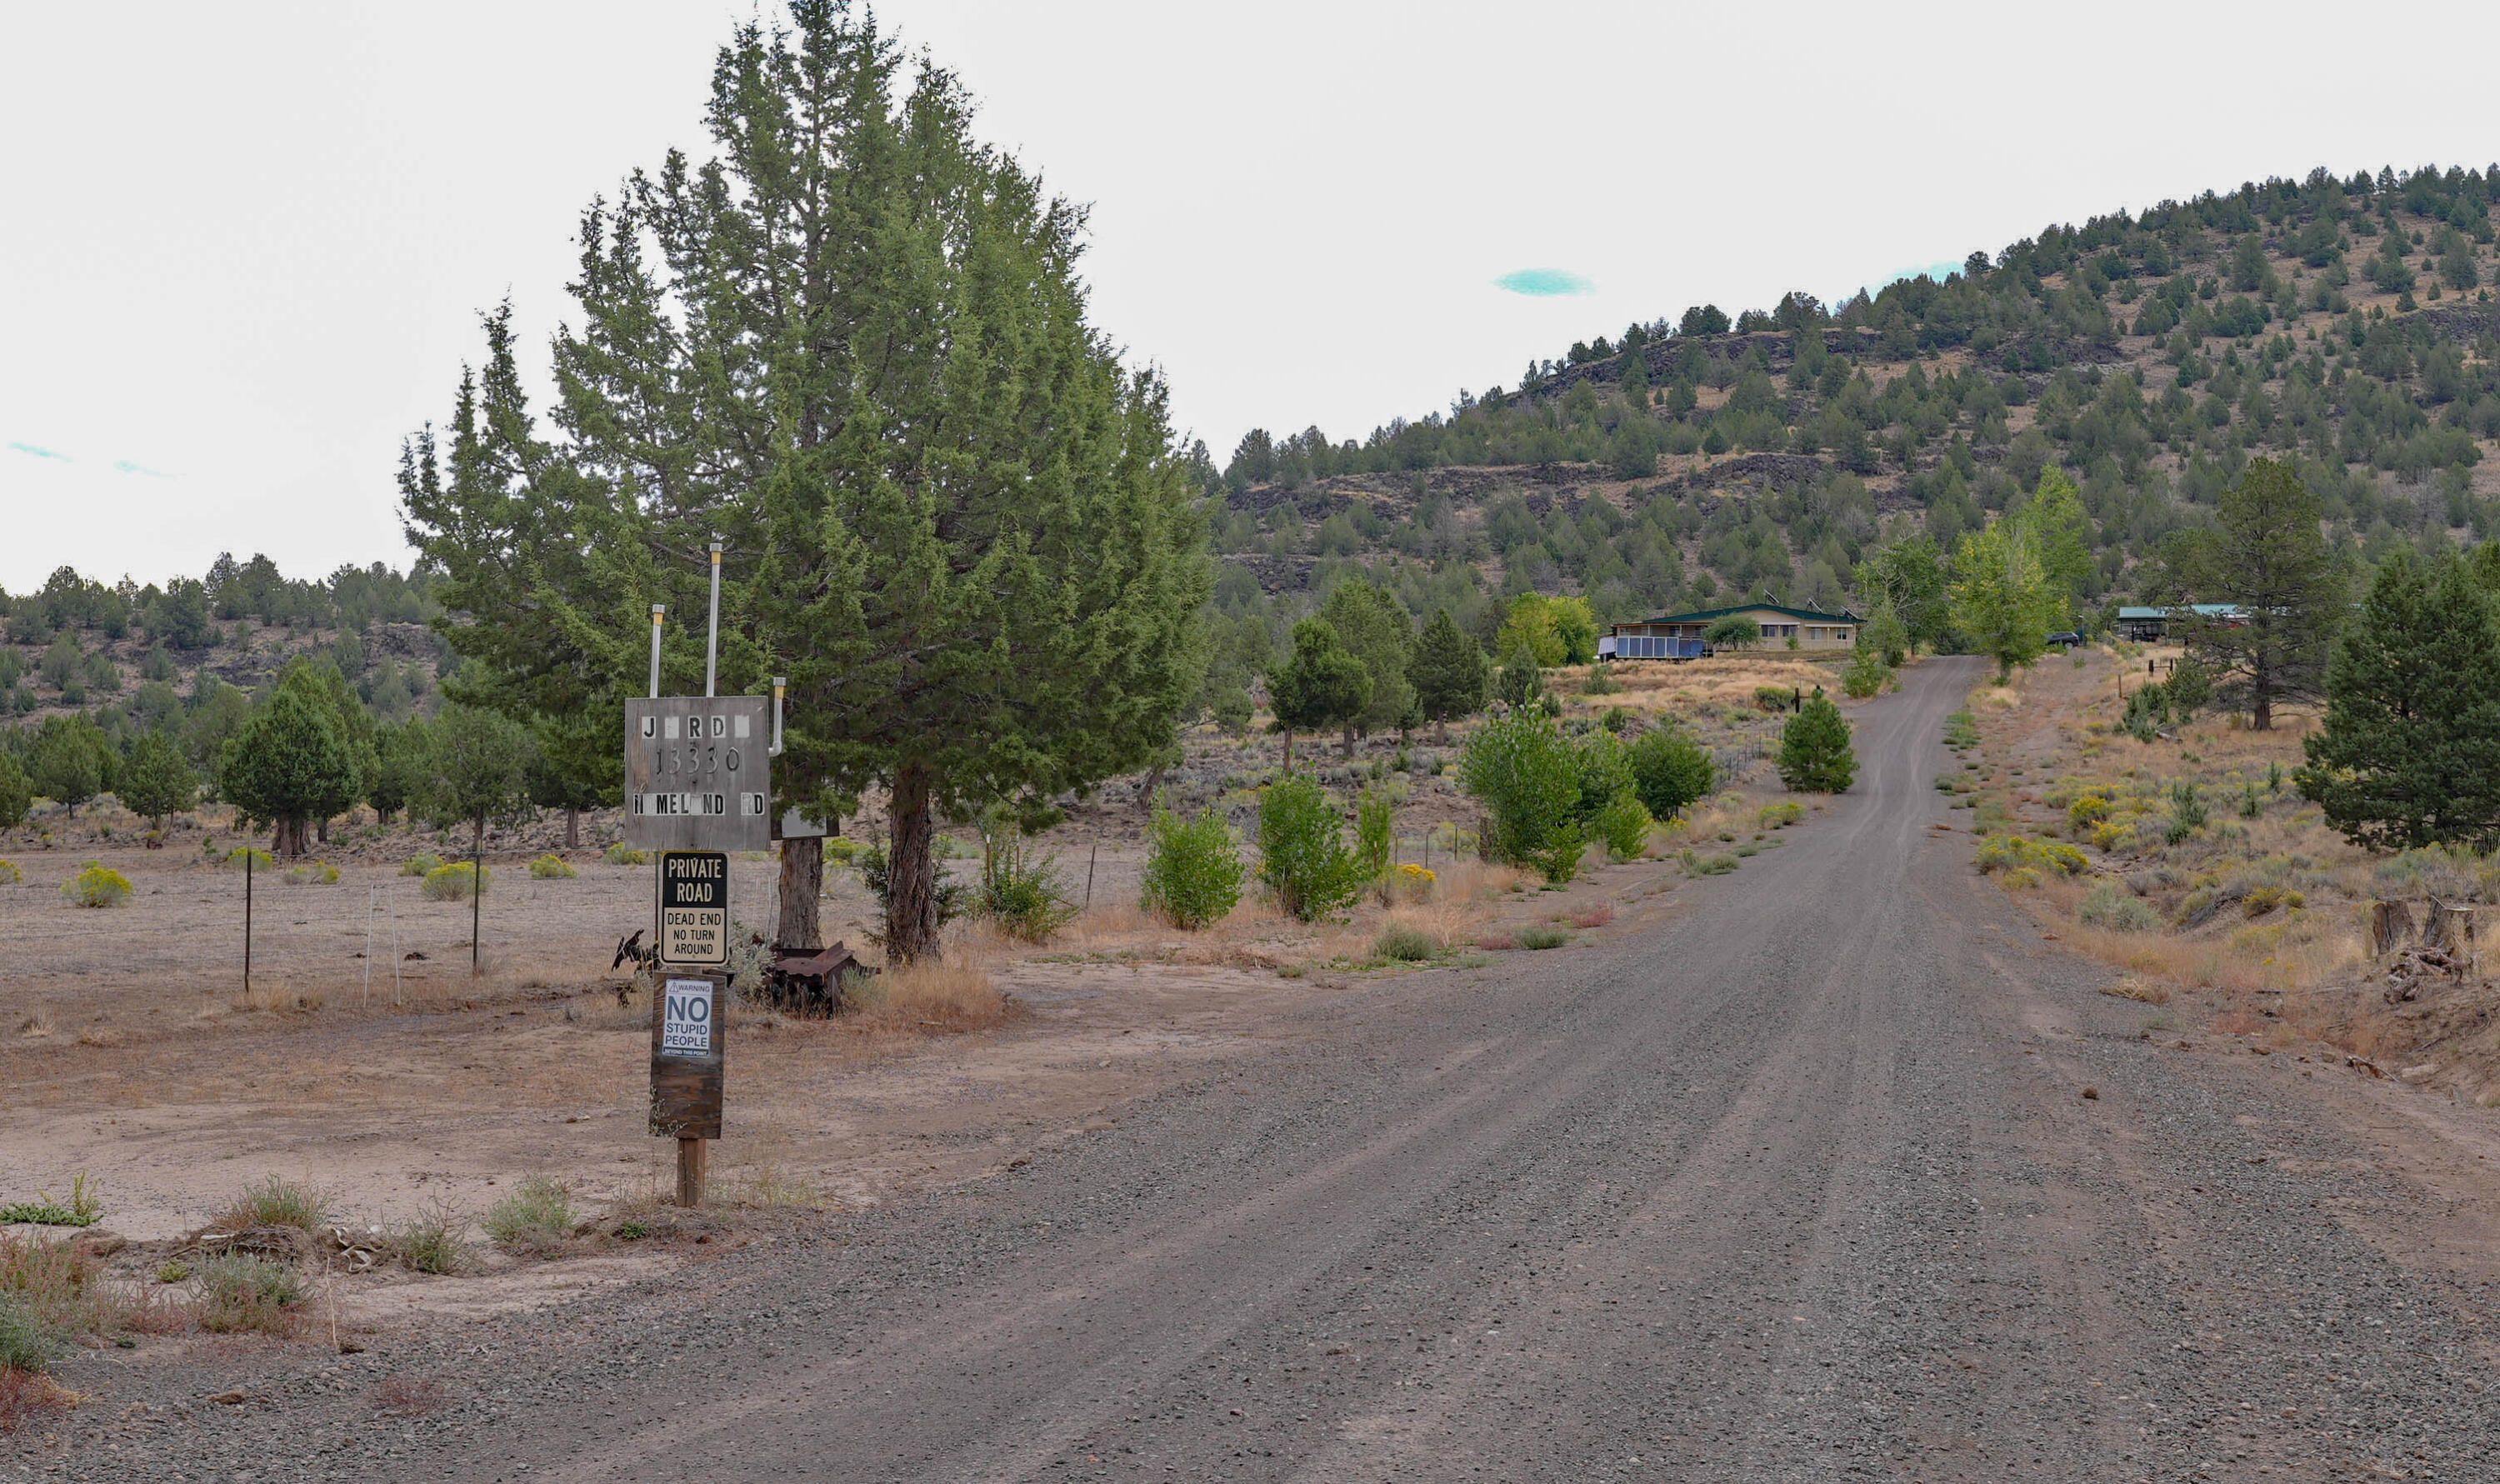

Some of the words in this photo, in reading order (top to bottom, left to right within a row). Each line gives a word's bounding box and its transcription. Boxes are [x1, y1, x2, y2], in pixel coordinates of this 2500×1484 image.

[643, 717, 750, 738] JRD
[633, 793, 724, 815] HMELND
[668, 858, 722, 878] PRIVATE
[677, 882, 712, 902] ROAD
[668, 913, 695, 925] DEAD
[700, 913, 722, 926] END
[673, 930, 687, 940] NO
[691, 930, 714, 941] TURN
[674, 944, 713, 955] AROUND
[667, 996, 709, 1022] NO
[667, 1022, 708, 1035] STUPID
[665, 1035, 708, 1047] PEOPLE
